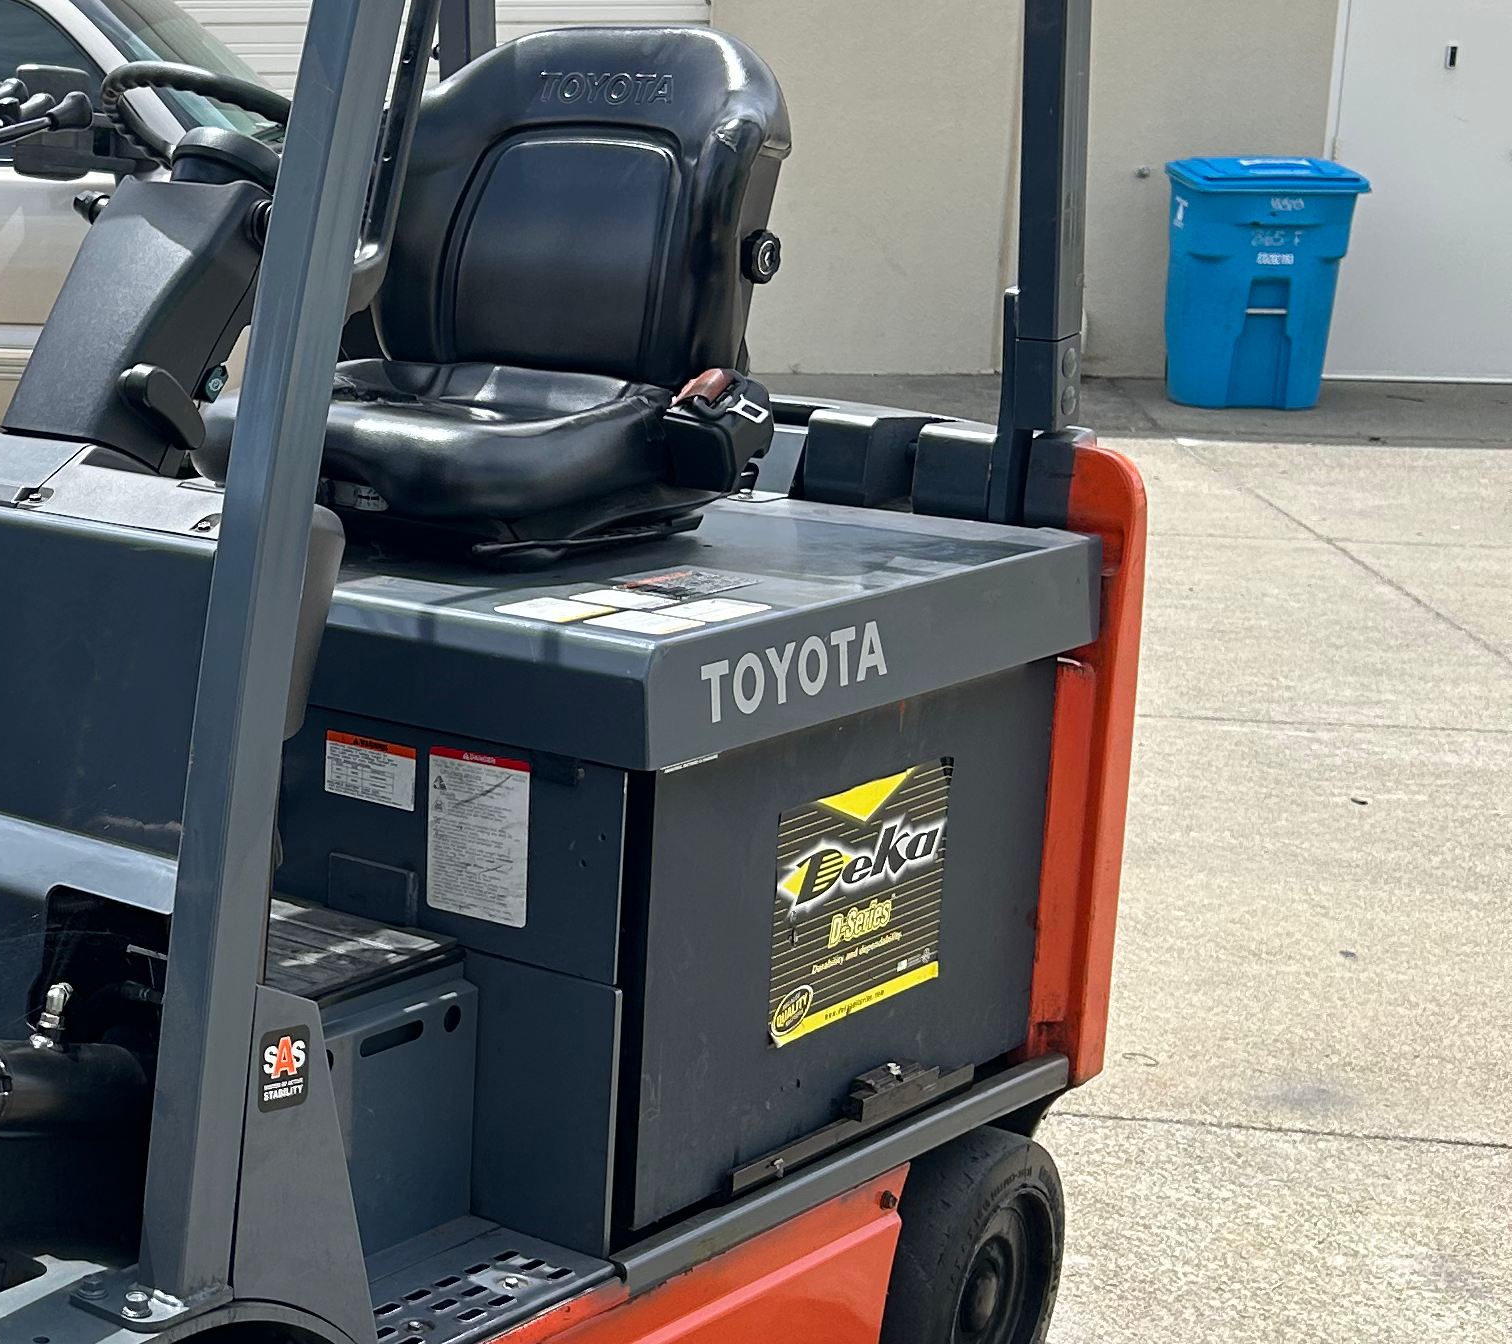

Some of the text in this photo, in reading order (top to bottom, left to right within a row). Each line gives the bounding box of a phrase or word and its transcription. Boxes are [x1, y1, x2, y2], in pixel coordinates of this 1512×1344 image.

[539, 69, 675, 105] TOYOTA
[700, 620, 888, 724] TOYOTA
[795, 822, 940, 908] Deka
[827, 899, 893, 949] D-Series
[262, 1035, 306, 1080] SAS
[263, 1084, 304, 1102] STABILITY
